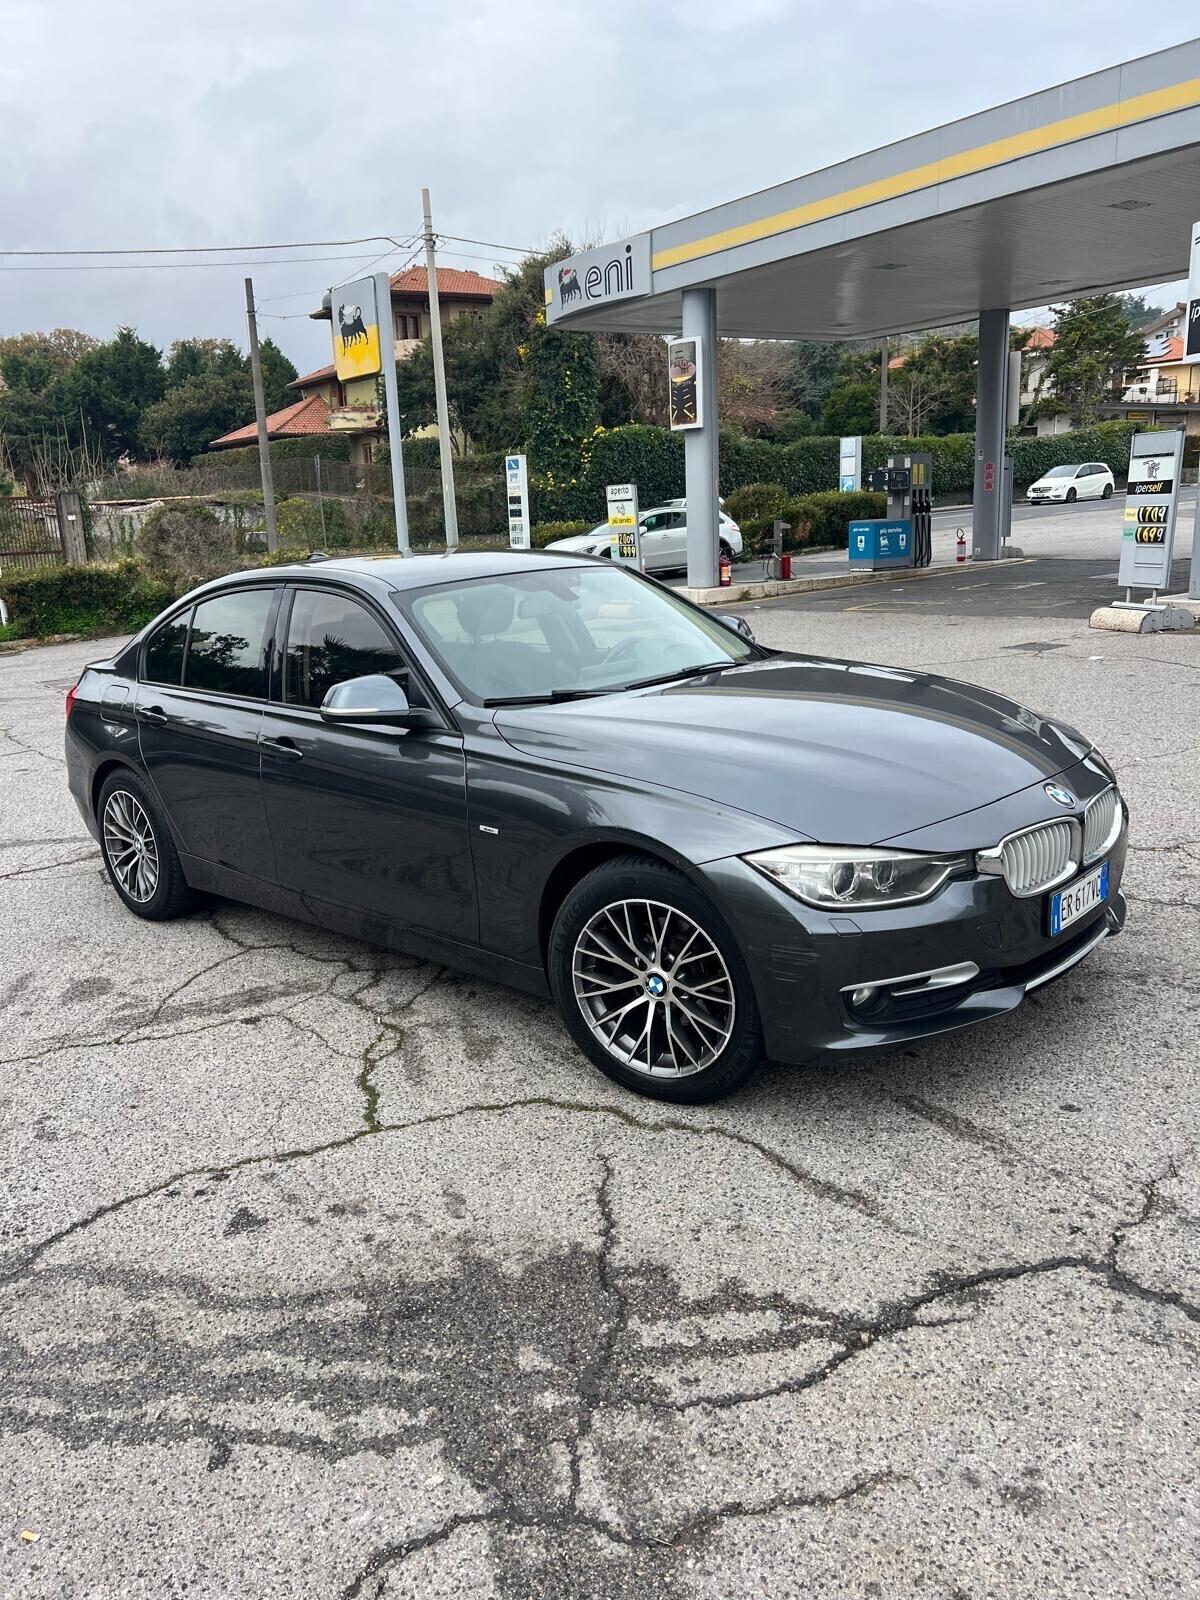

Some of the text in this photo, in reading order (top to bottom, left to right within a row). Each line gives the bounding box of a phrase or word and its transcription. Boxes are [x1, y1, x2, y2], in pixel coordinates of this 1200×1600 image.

[585, 244, 633, 300] eni
[868, 474, 873, 482] 4
[884, 473, 889, 481] 3
[610, 486, 629, 496] aperto
[1135, 482, 1164, 494] iperself
[619, 516, 632, 524] servito
[1136, 527, 1164, 542] 1699
[1061, 894, 1073, 921] ER
